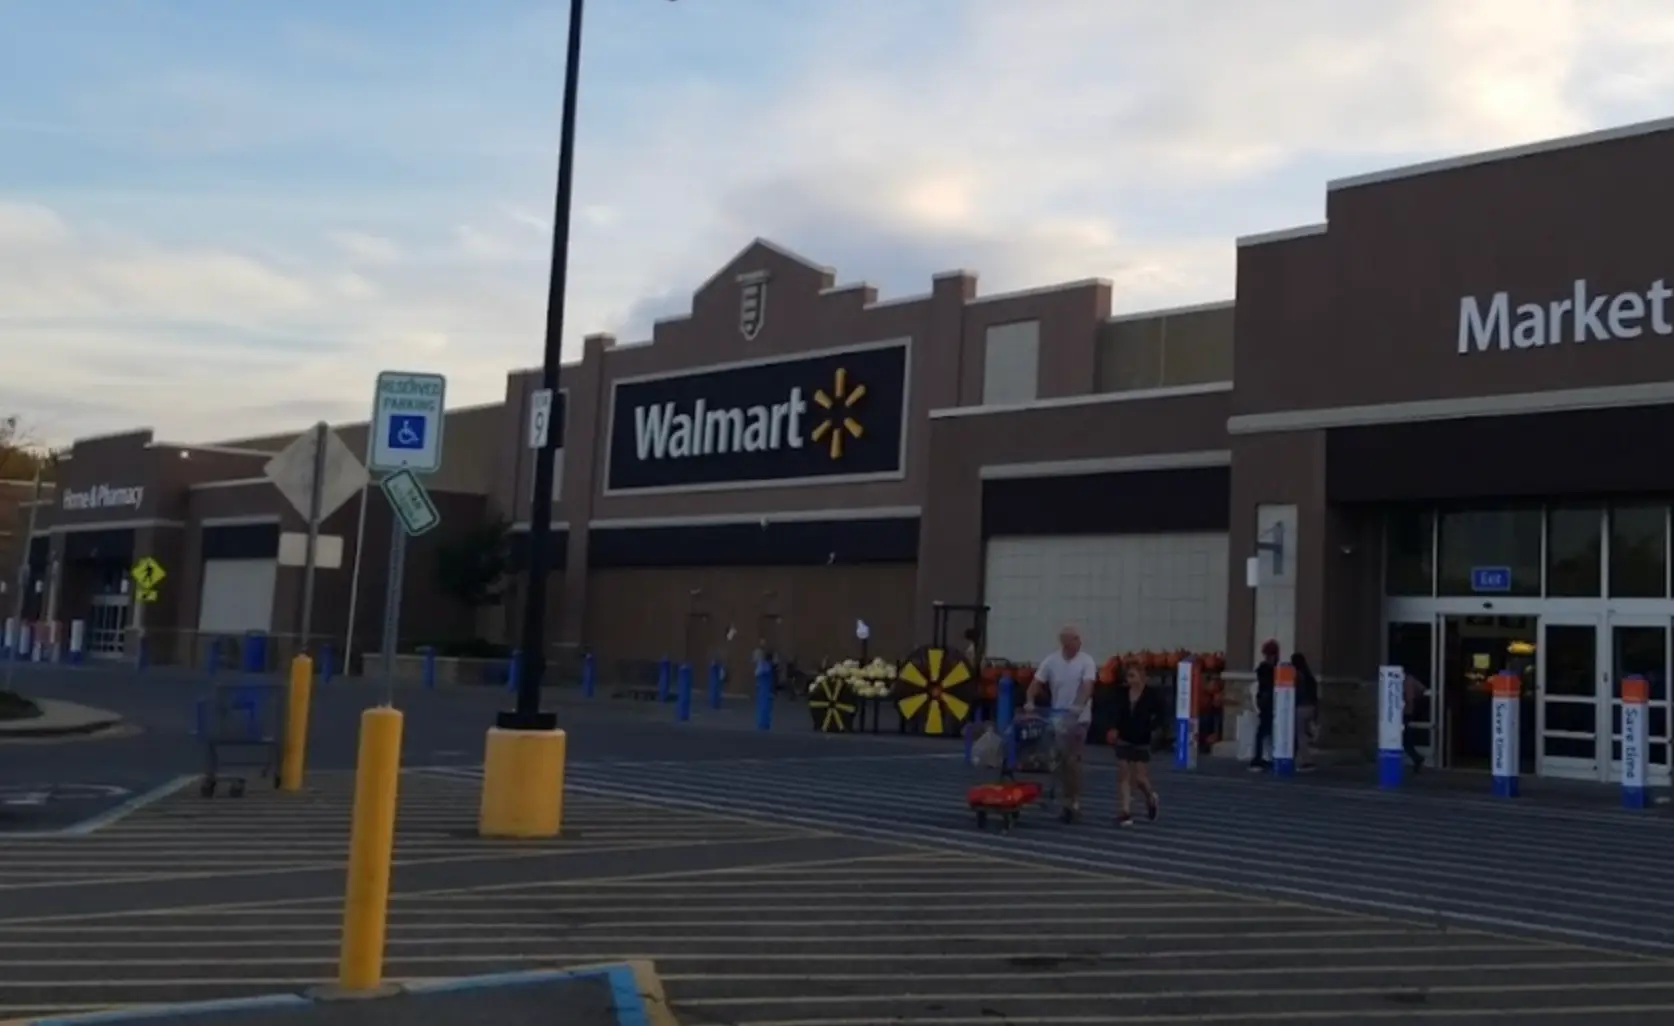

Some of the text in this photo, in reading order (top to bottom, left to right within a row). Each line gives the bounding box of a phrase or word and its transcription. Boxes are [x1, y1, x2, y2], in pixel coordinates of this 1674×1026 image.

[1457, 279, 1673, 354] Market
[383, 397, 435, 412] PARKING
[634, 386, 807, 461] Walmart
[1625, 708, 1641, 779] Save time
